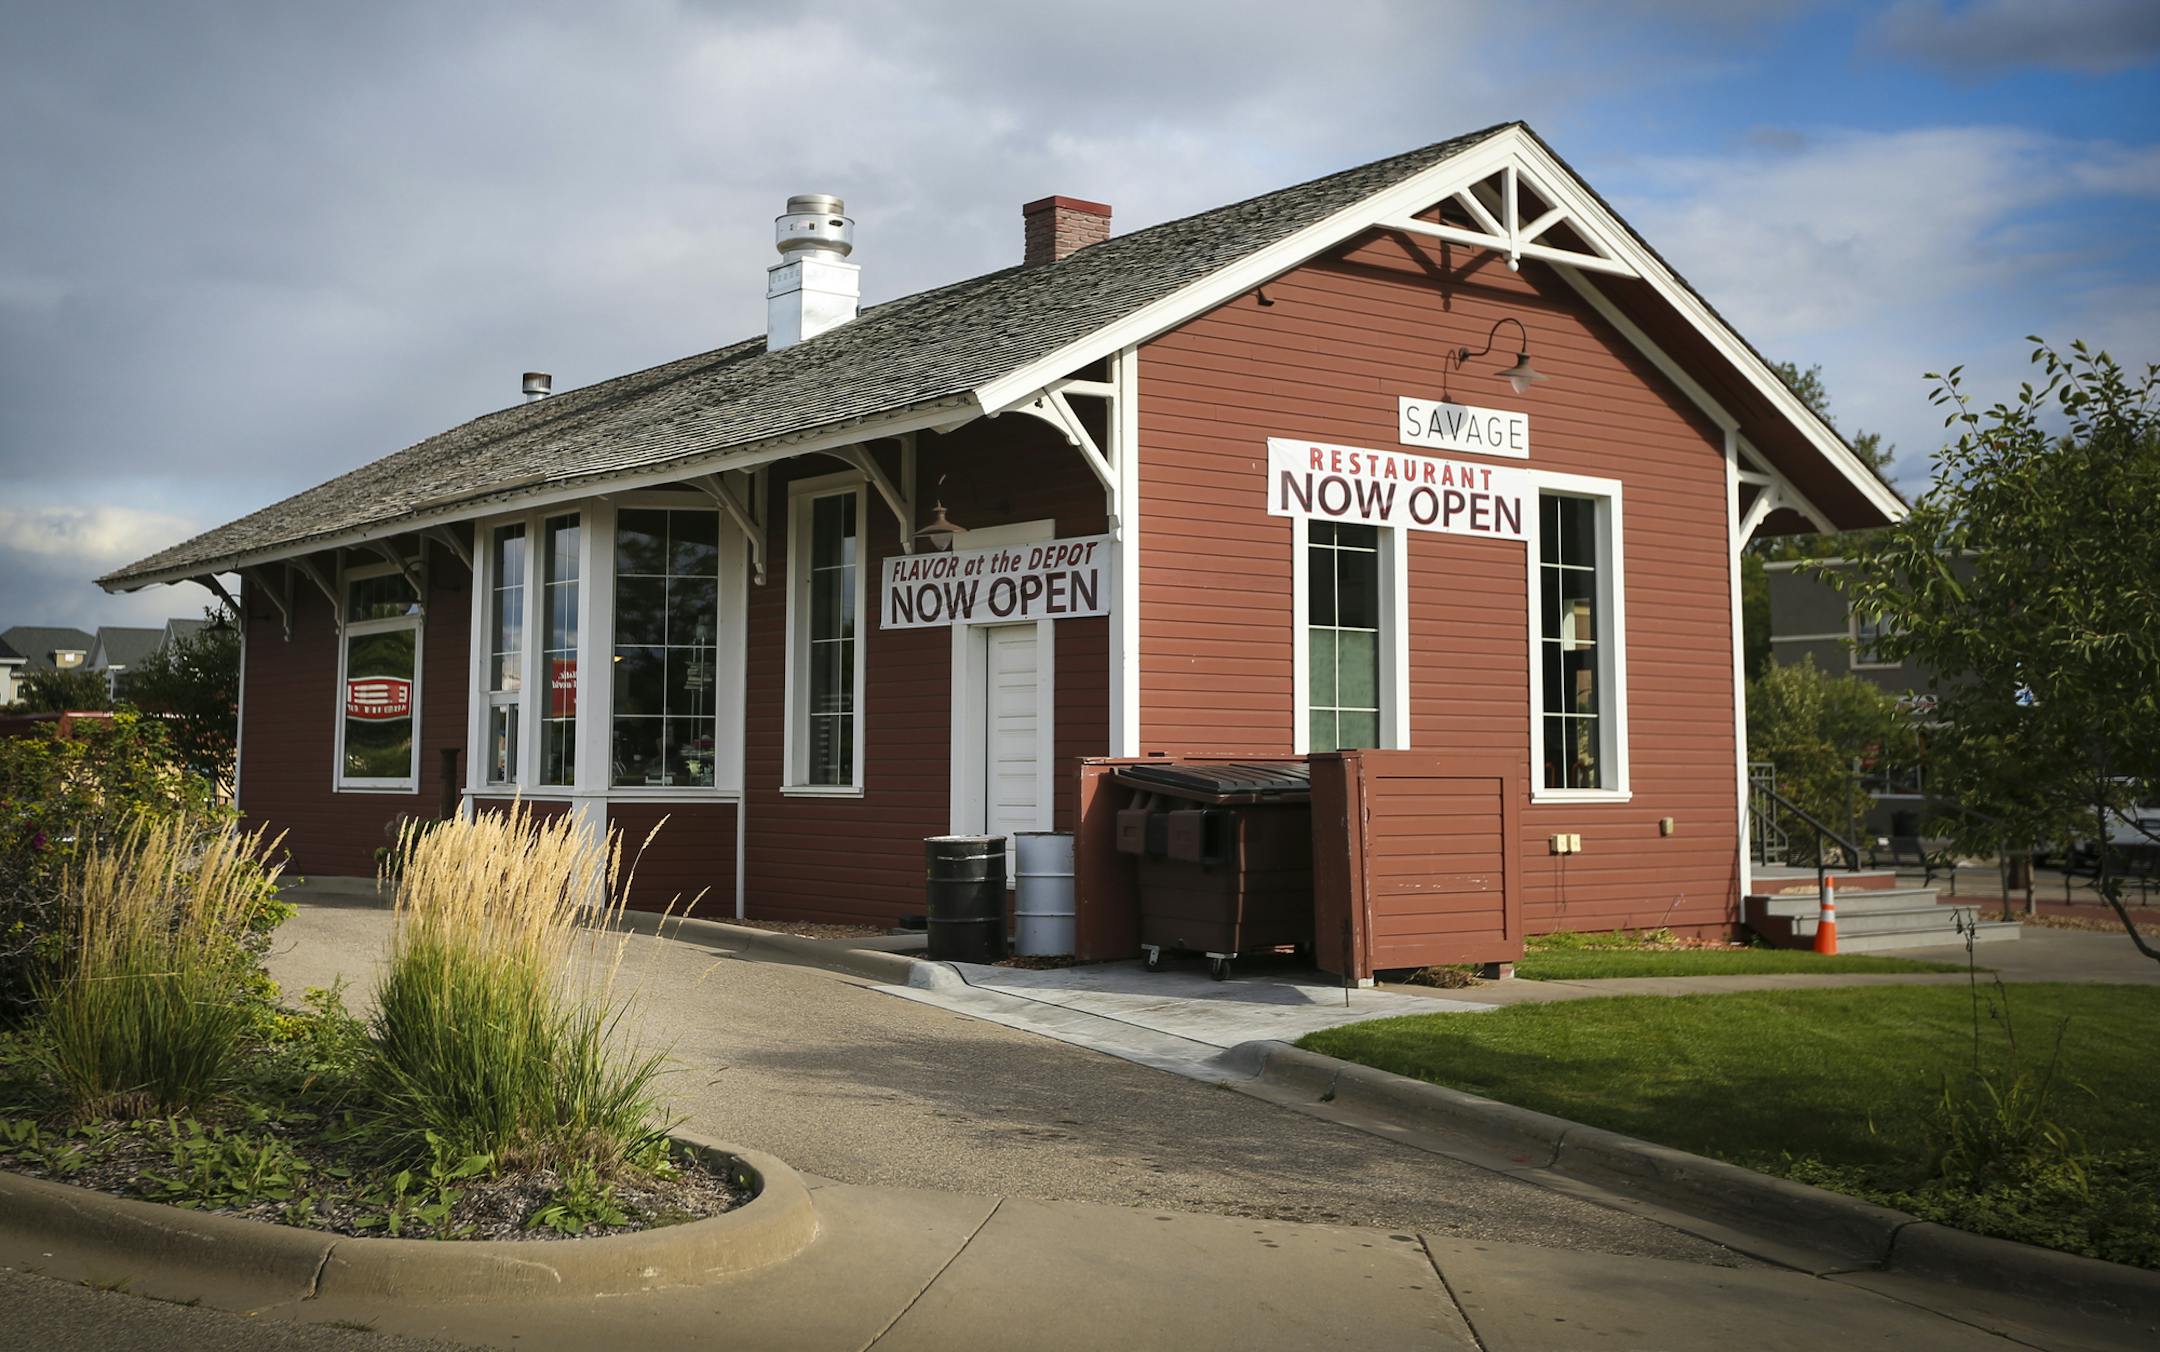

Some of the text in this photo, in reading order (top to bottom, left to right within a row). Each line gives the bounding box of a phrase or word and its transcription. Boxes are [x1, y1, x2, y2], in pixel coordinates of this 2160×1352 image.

[1406, 405, 1523, 450] SAVAGE
[1309, 447, 1492, 490] RESTAURANT
[1280, 470, 1522, 534] NOW OPEN
[892, 541, 1099, 582] FLAVOR at the DEPOT
[891, 568, 1099, 624] NOW OPEN
